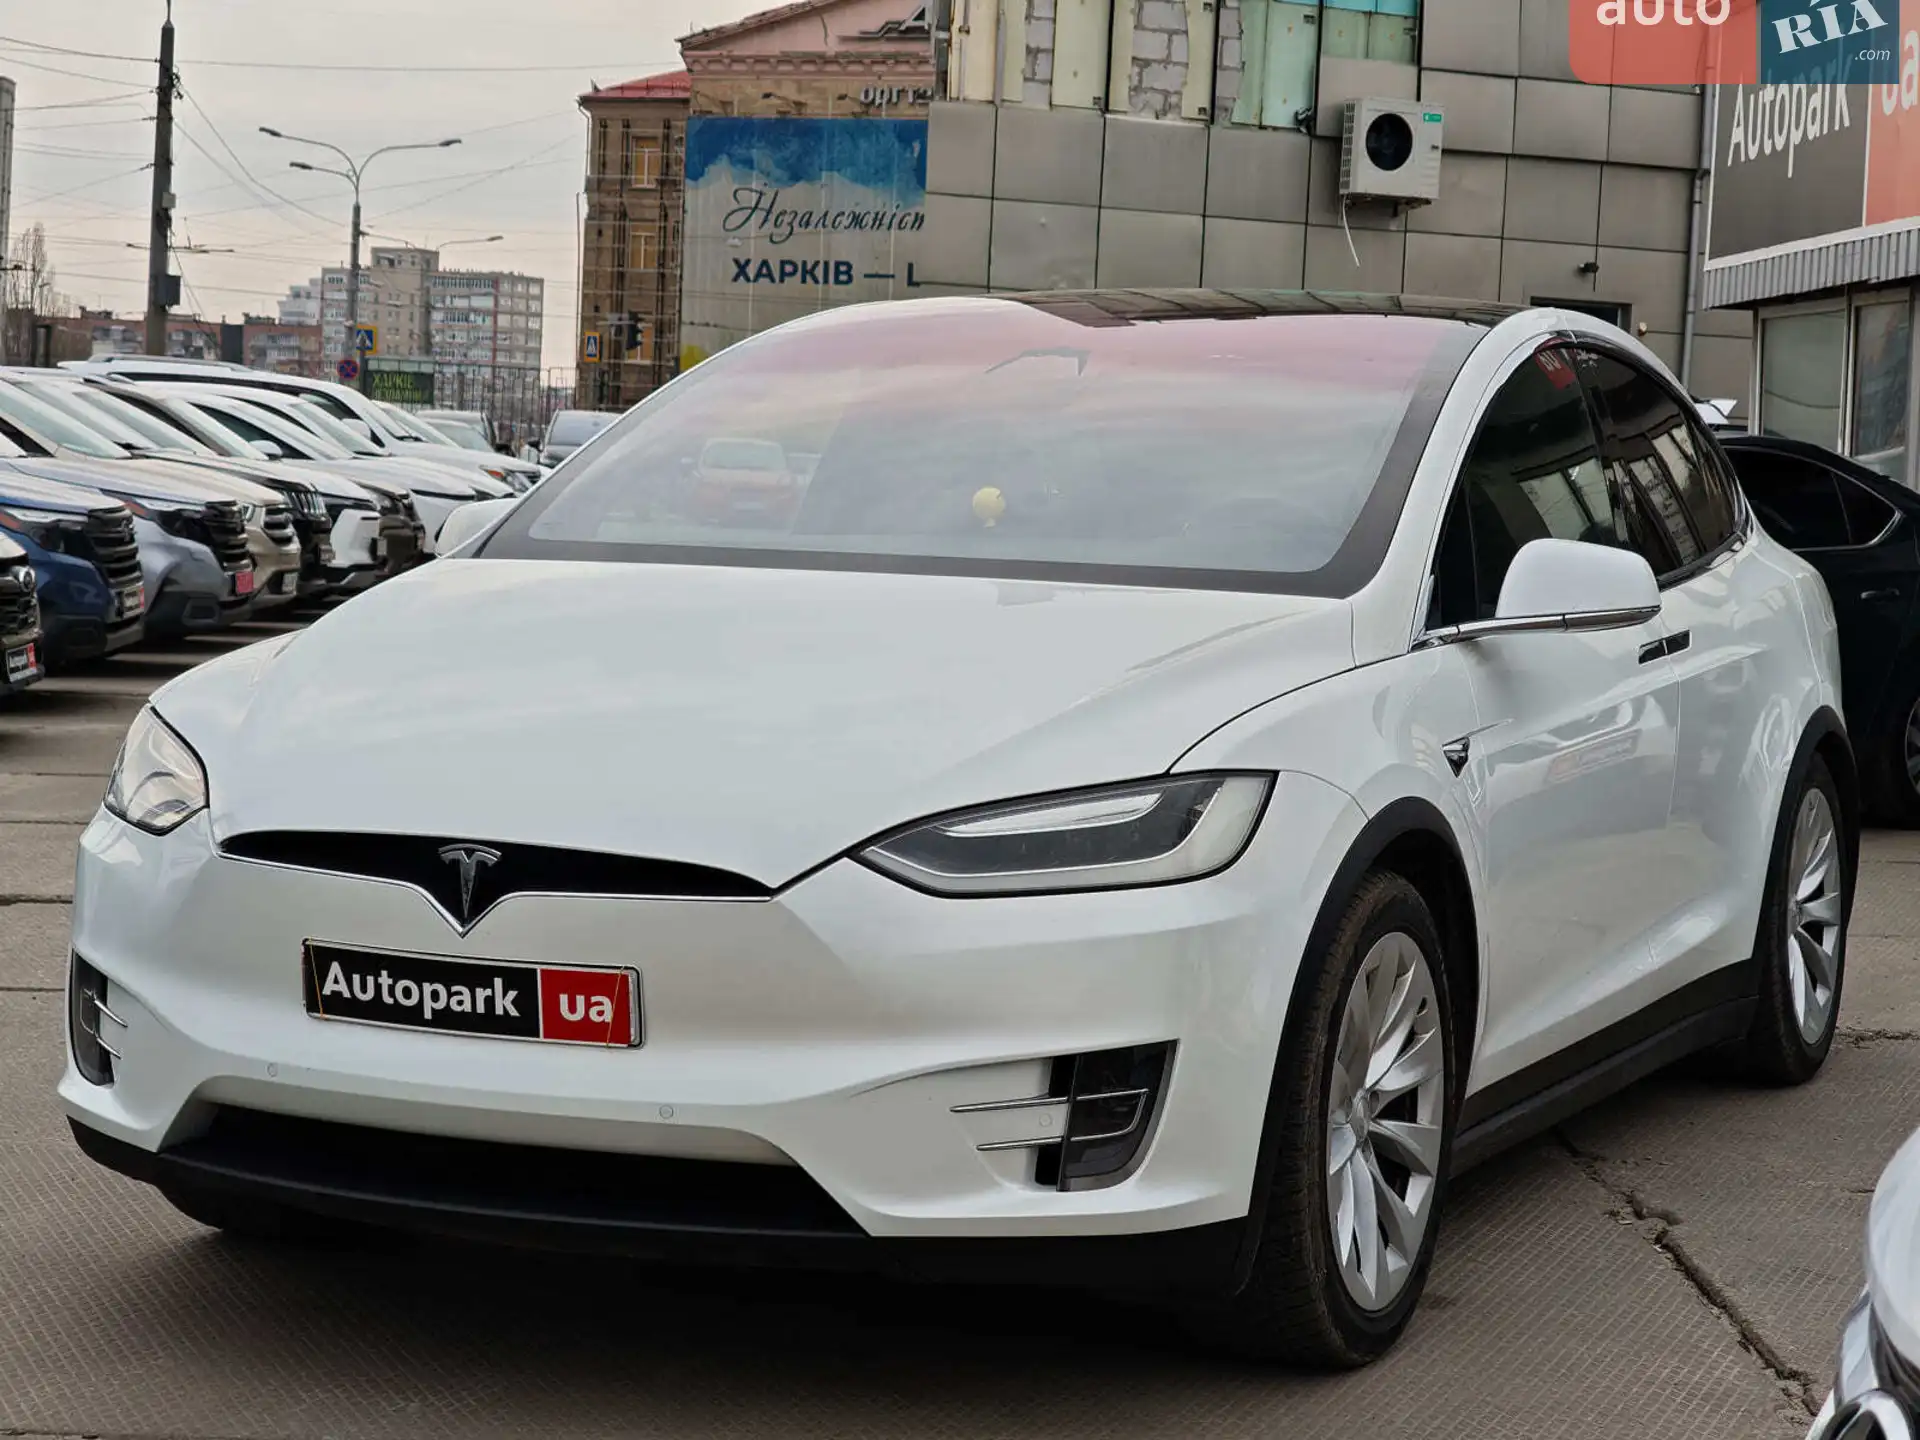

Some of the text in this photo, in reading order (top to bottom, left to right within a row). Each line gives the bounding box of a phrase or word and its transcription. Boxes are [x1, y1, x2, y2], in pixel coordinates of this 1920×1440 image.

[1727, 45, 1850, 178] Autopark
[731, 257, 854, 285] ХАРКІВ
[321, 961, 615, 1023] Autopark ua
